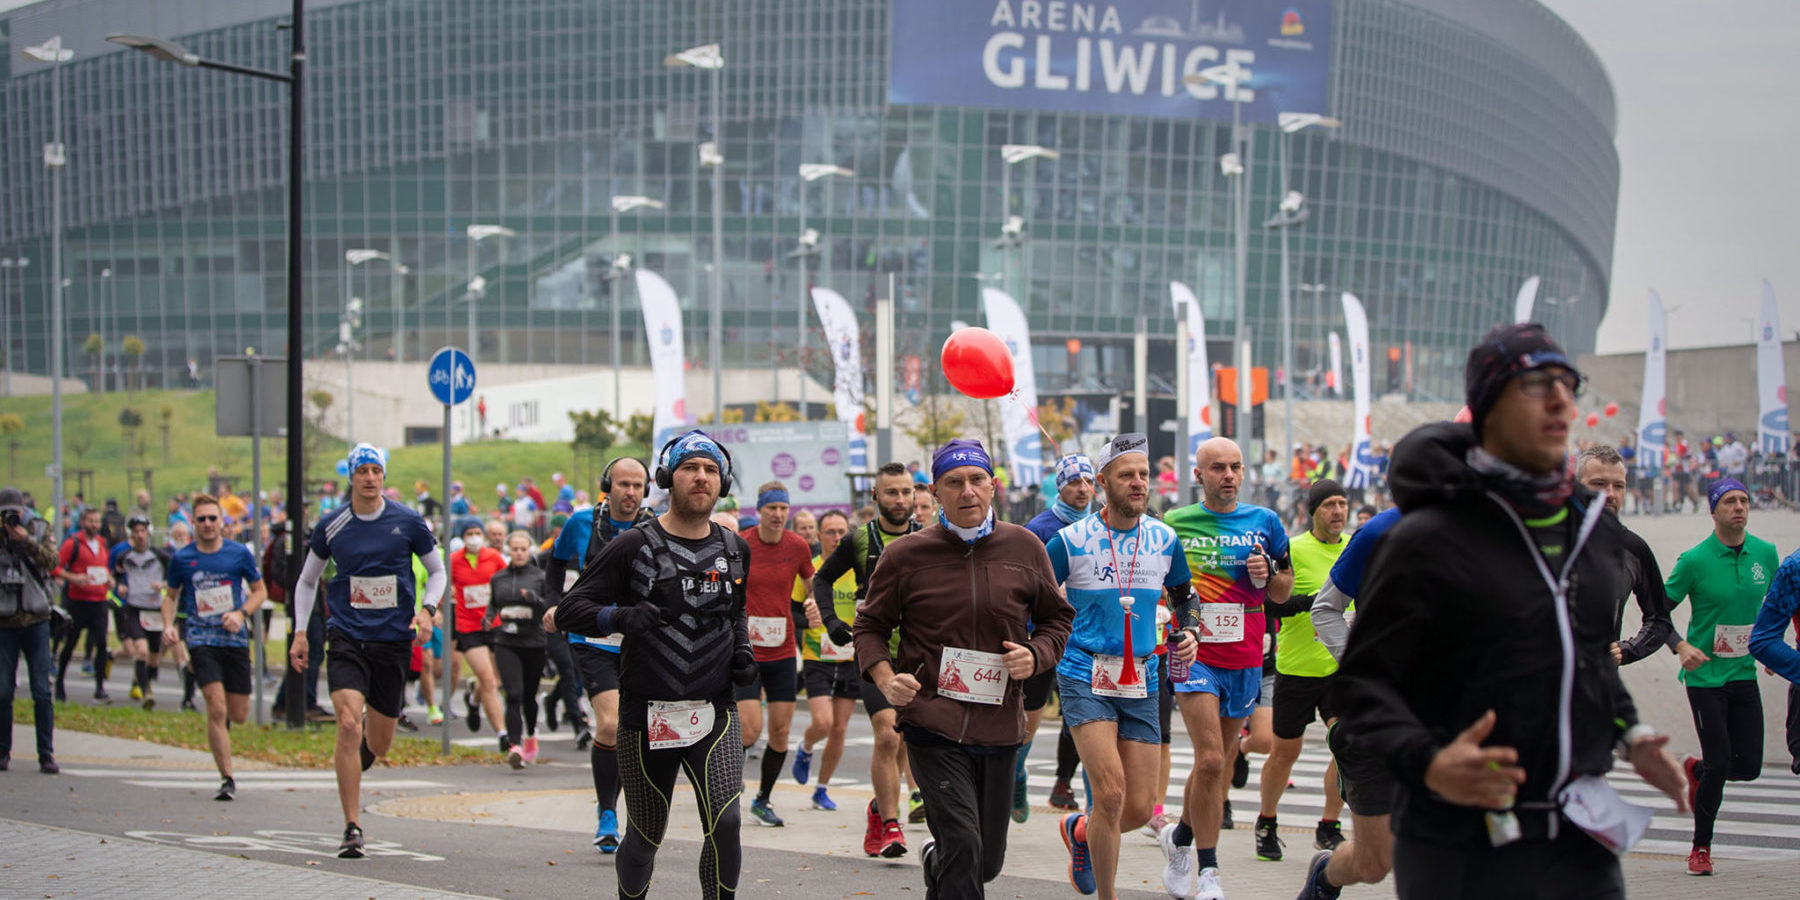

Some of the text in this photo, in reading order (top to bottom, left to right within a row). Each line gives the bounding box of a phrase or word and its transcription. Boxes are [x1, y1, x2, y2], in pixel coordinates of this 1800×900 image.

[991, 0, 1122, 35] ARENA
[982, 32, 1256, 102] GLIWICE
[373, 586, 392, 596] 269
[1216, 616, 1238, 627] 152
[767, 627, 782, 635] 341
[973, 668, 1001, 684] 644
[690, 711, 699, 725] 6
